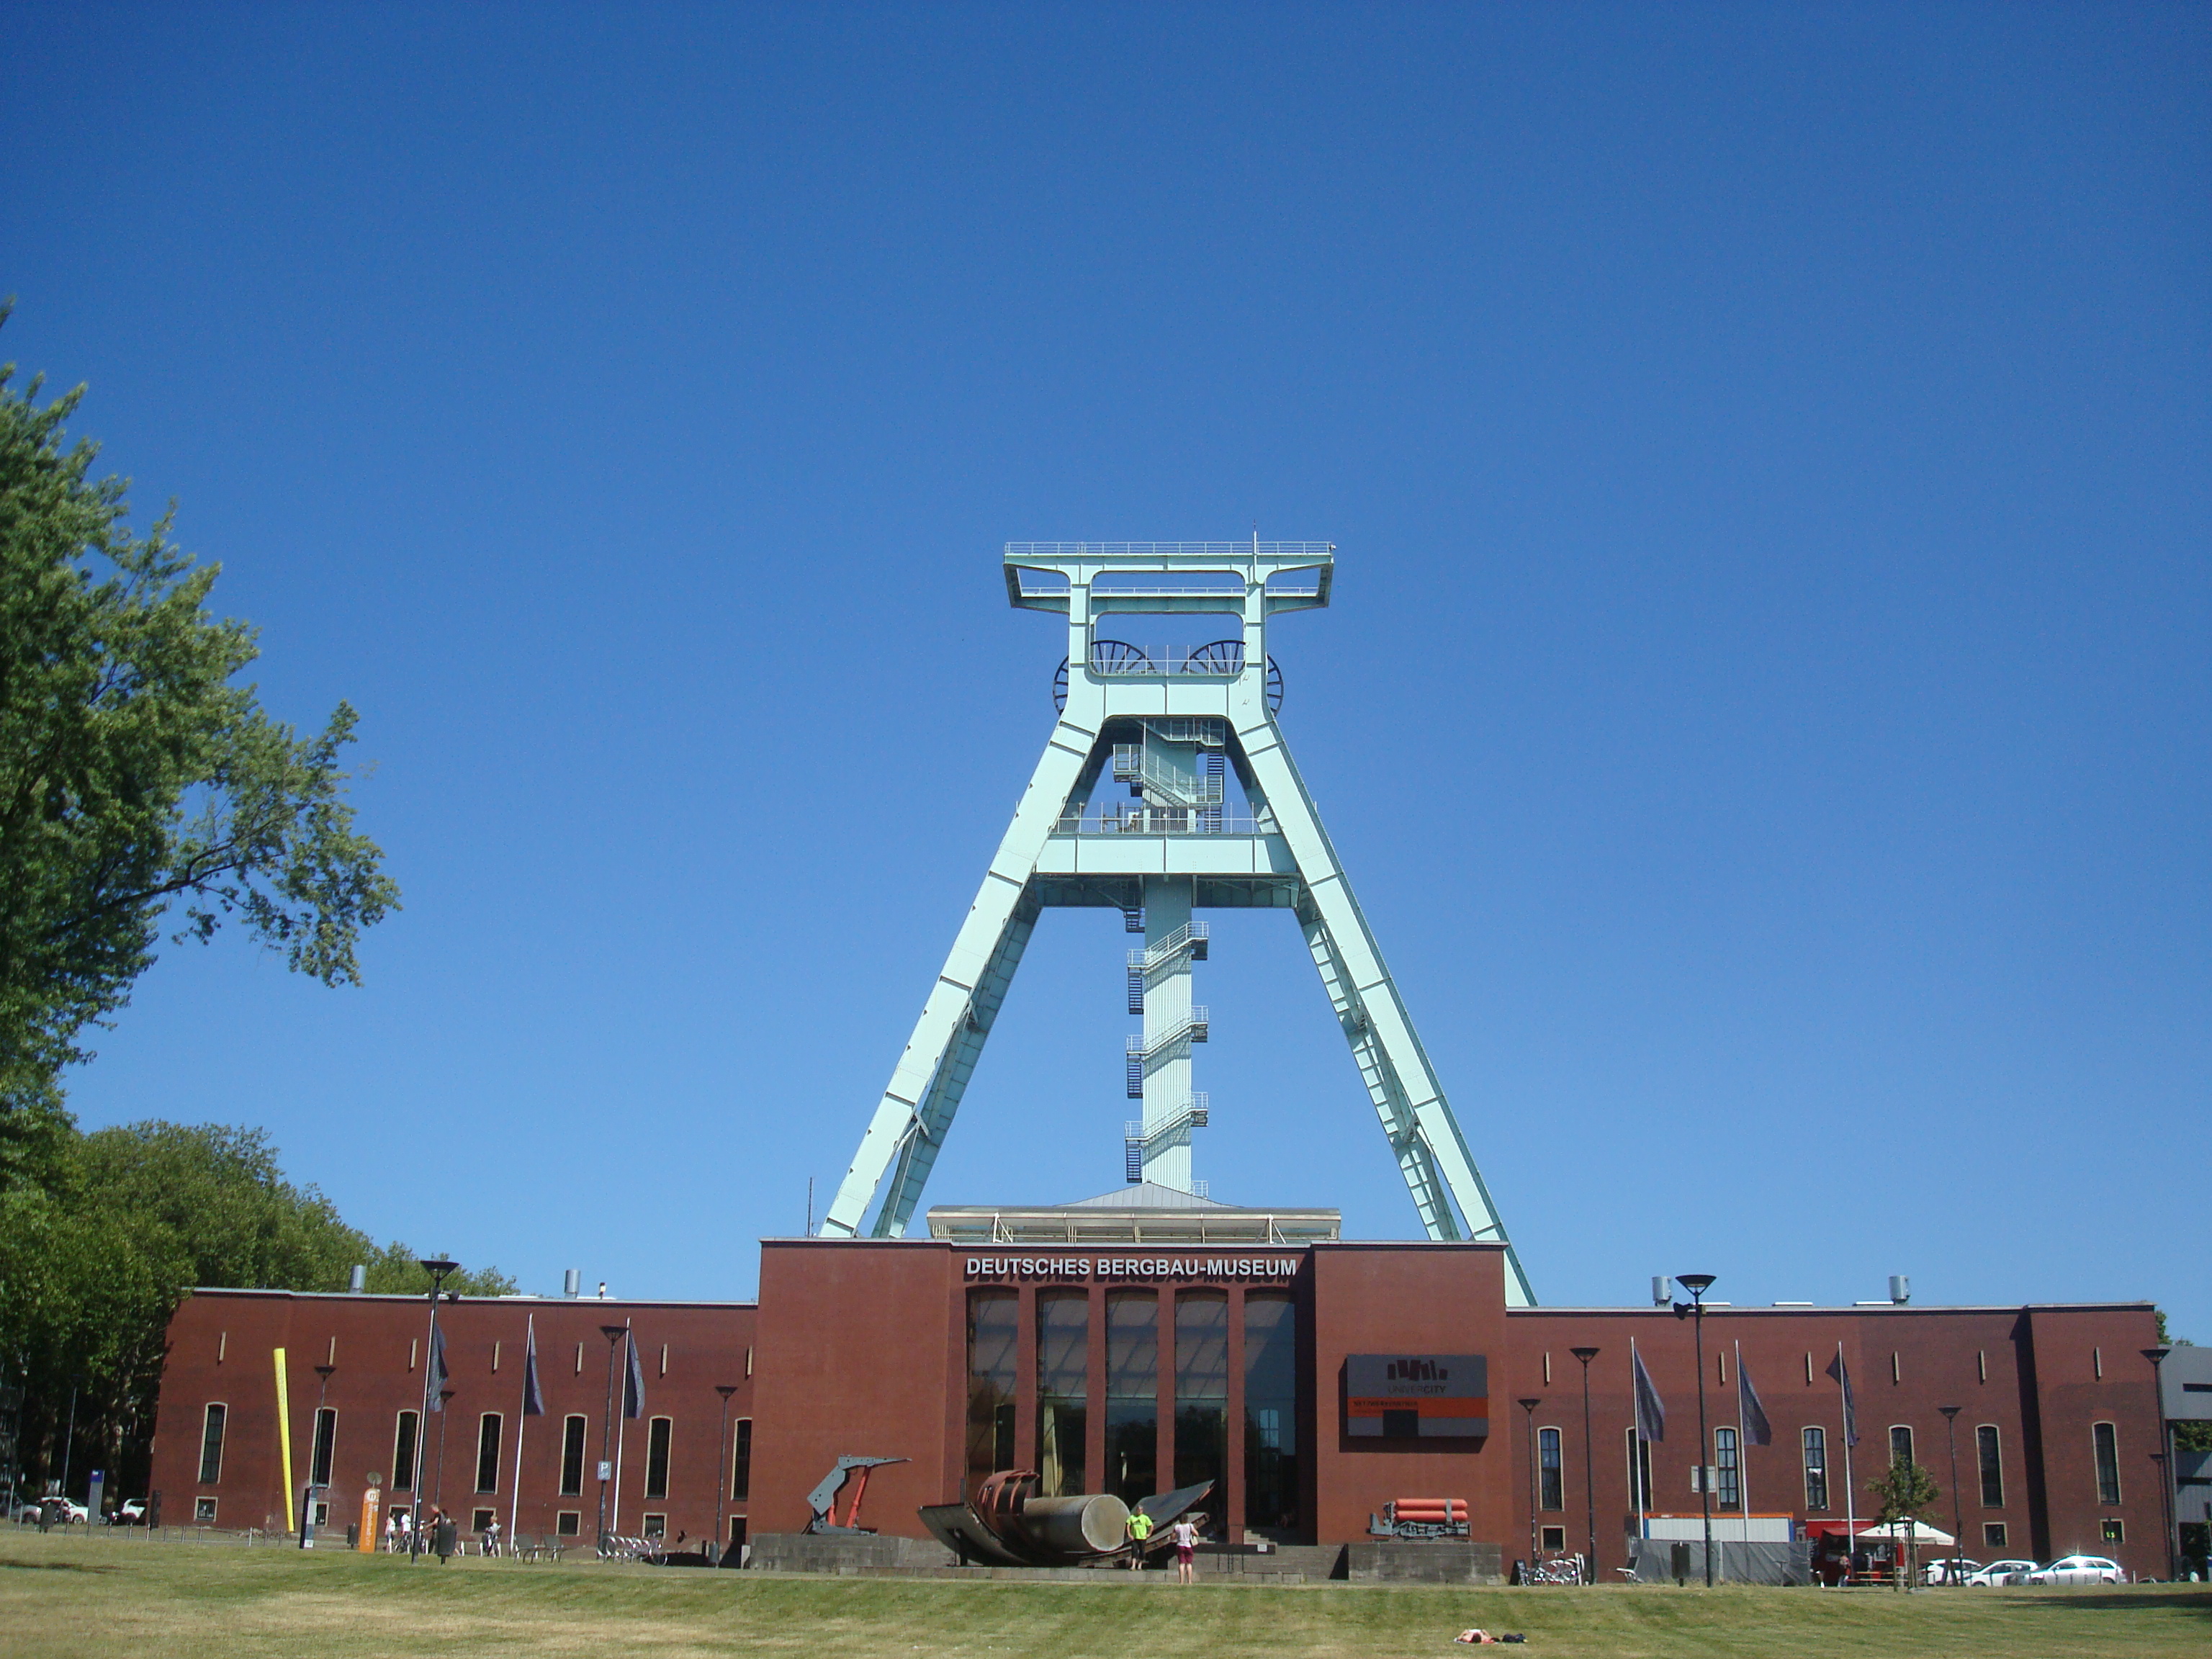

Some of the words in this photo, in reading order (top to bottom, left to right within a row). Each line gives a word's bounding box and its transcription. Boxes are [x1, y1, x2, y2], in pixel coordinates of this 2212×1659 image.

[967, 1258, 1090, 1274] DEUTSCHES
[1097, 1259, 1296, 1276] BERGBAU-MUSEUM
[1388, 1385, 1447, 1394] UNIVERCITY
[601, 1462, 608, 1472] P
